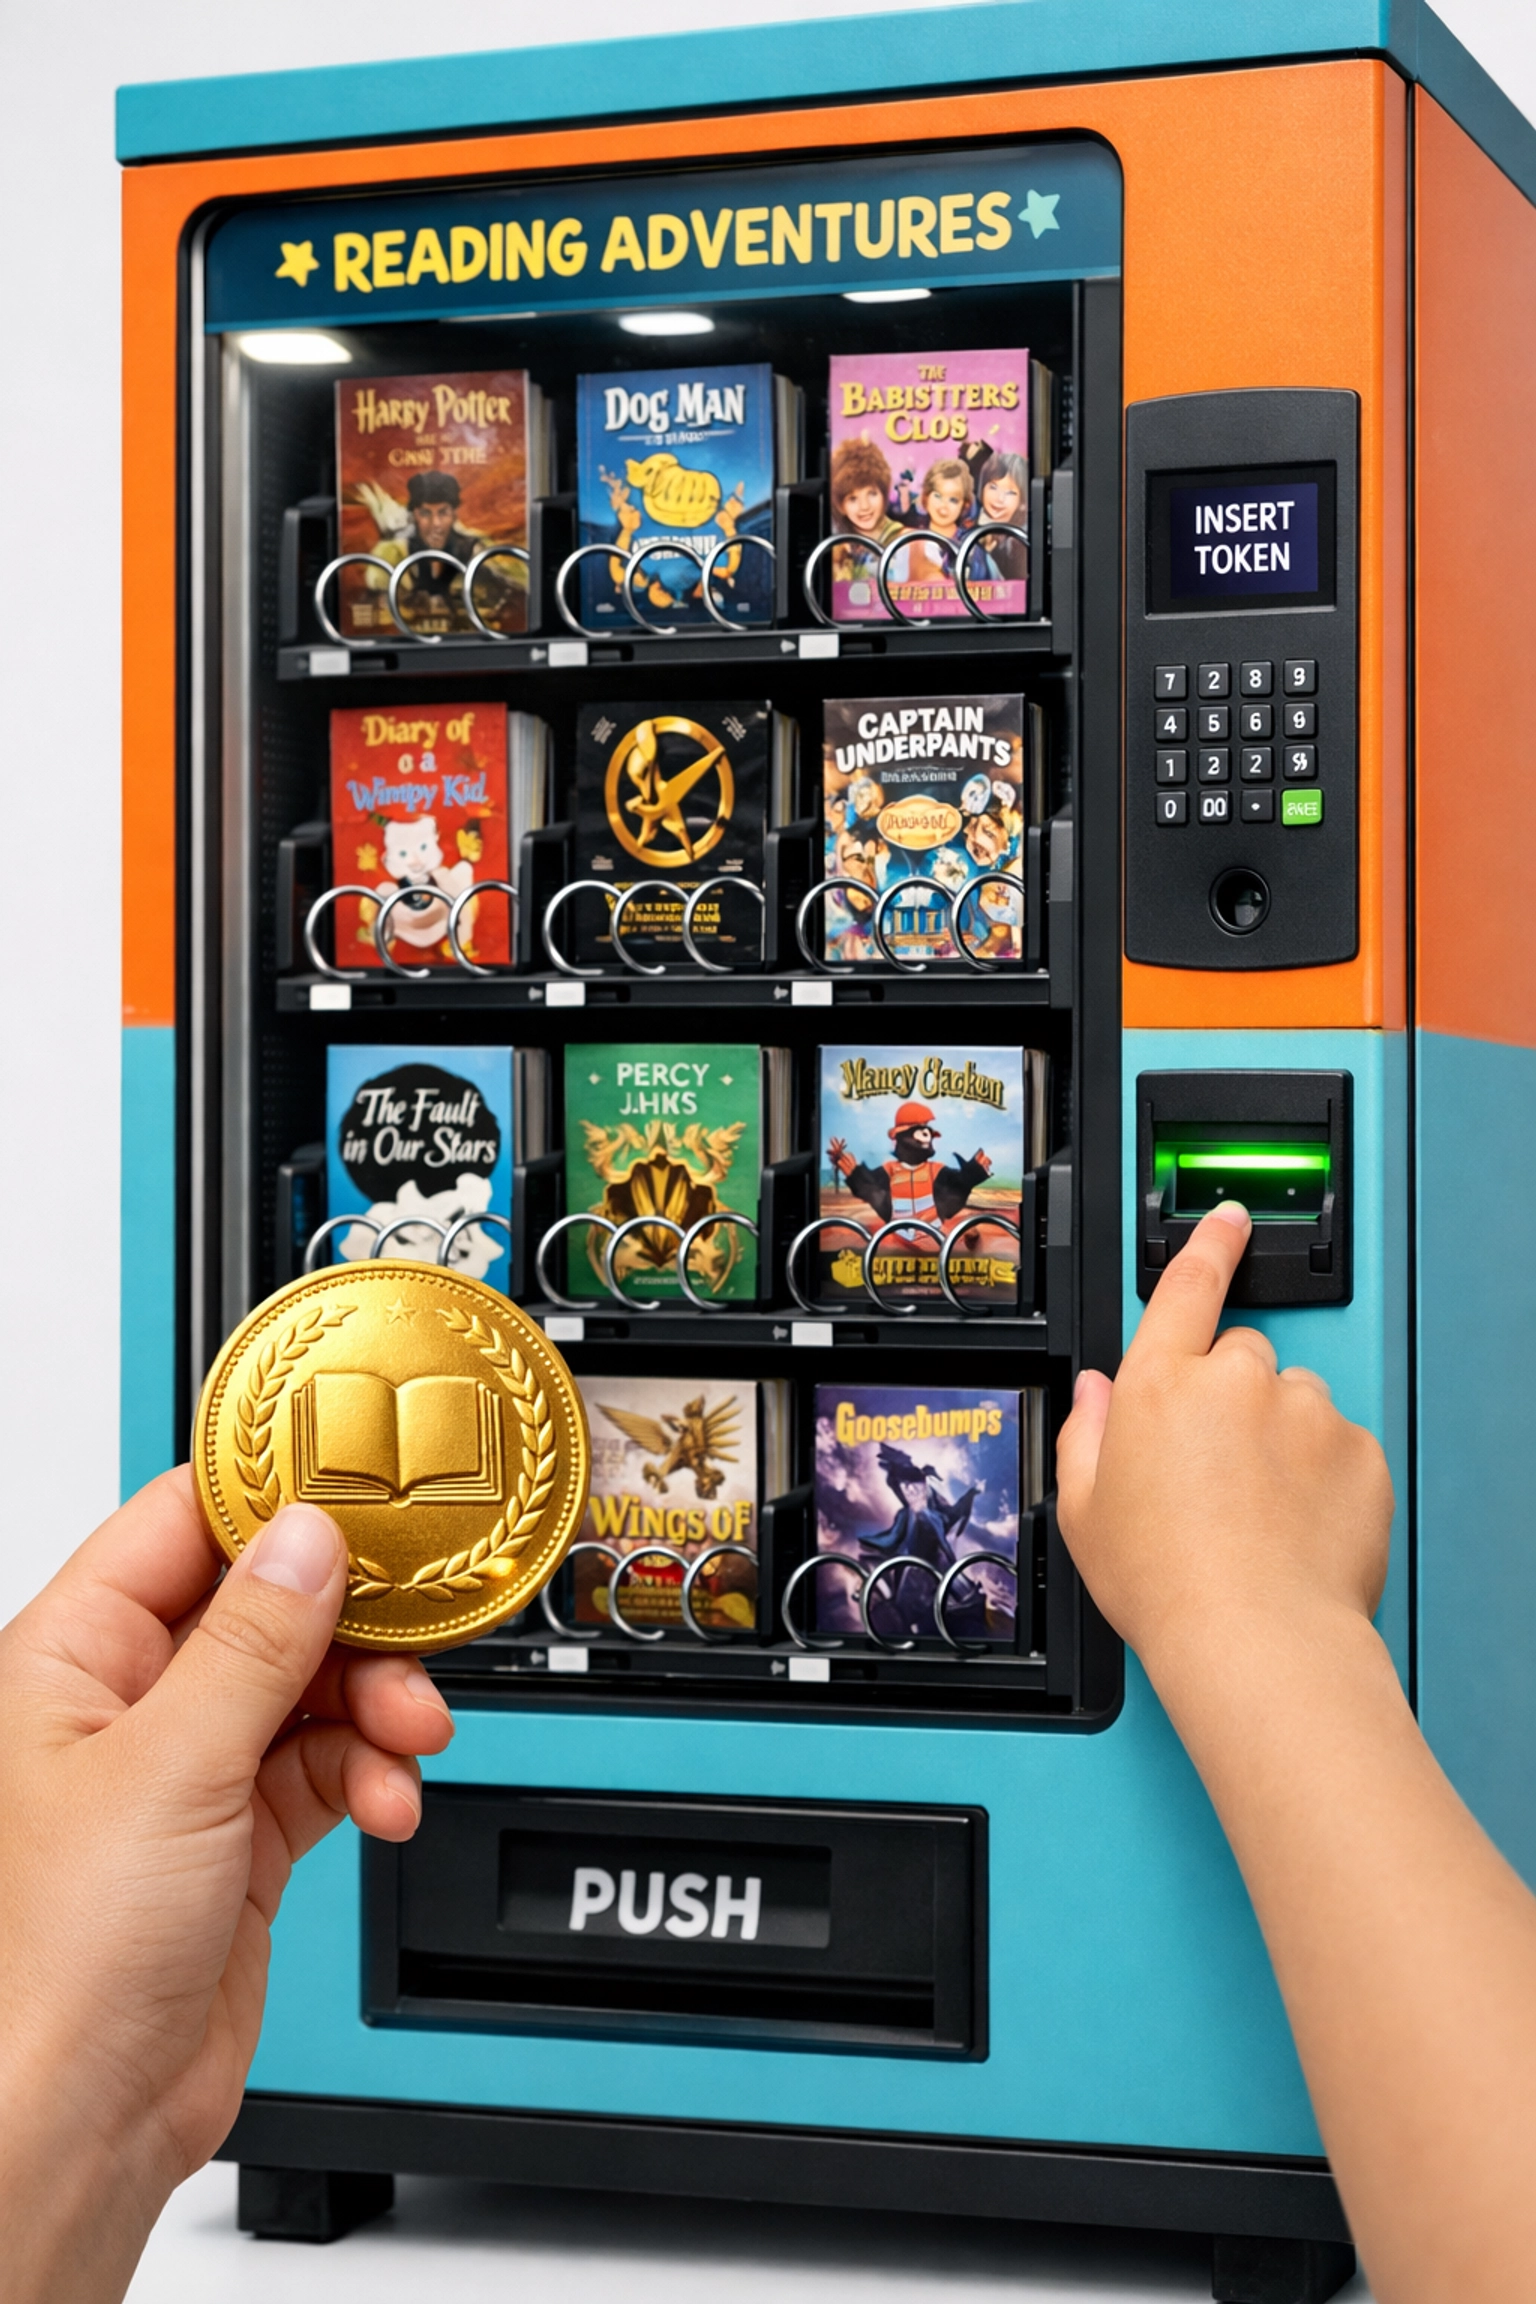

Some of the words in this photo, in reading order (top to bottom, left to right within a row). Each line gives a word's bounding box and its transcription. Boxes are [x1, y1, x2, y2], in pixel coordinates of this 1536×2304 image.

[333, 219, 588, 294] READING
[600, 191, 1013, 273] ADVENTURES
[1195, 501, 1295, 535] INSERT
[1195, 542, 1290, 575] TOKEN
[1164, 673, 1176, 691] 7
[1208, 671, 1220, 690] 2
[1249, 669, 1262, 688] 8
[360, 714, 440, 749] Diary
[446, 712, 475, 745] of
[858, 706, 984, 740] CAPTAIN
[1163, 715, 1177, 734] 4
[1208, 714, 1220, 733] 5
[1249, 712, 1262, 731] 6
[835, 732, 1012, 773] UNDERPANTS
[1165, 759, 1174, 777] 1
[1249, 754, 1262, 774] 2
[345, 776, 438, 812] Wimpy
[441, 771, 489, 807] Kid
[1164, 800, 1177, 819] 0
[617, 1062, 710, 1088] PERCY
[356, 1086, 407, 1127] The
[408, 1087, 481, 1132] Fault
[343, 1130, 368, 1165] in
[373, 1125, 425, 1166] Our
[423, 1125, 497, 1168] Stars
[835, 1401, 1003, 1448] Goosebumps
[568, 1866, 762, 1941] PUSH
